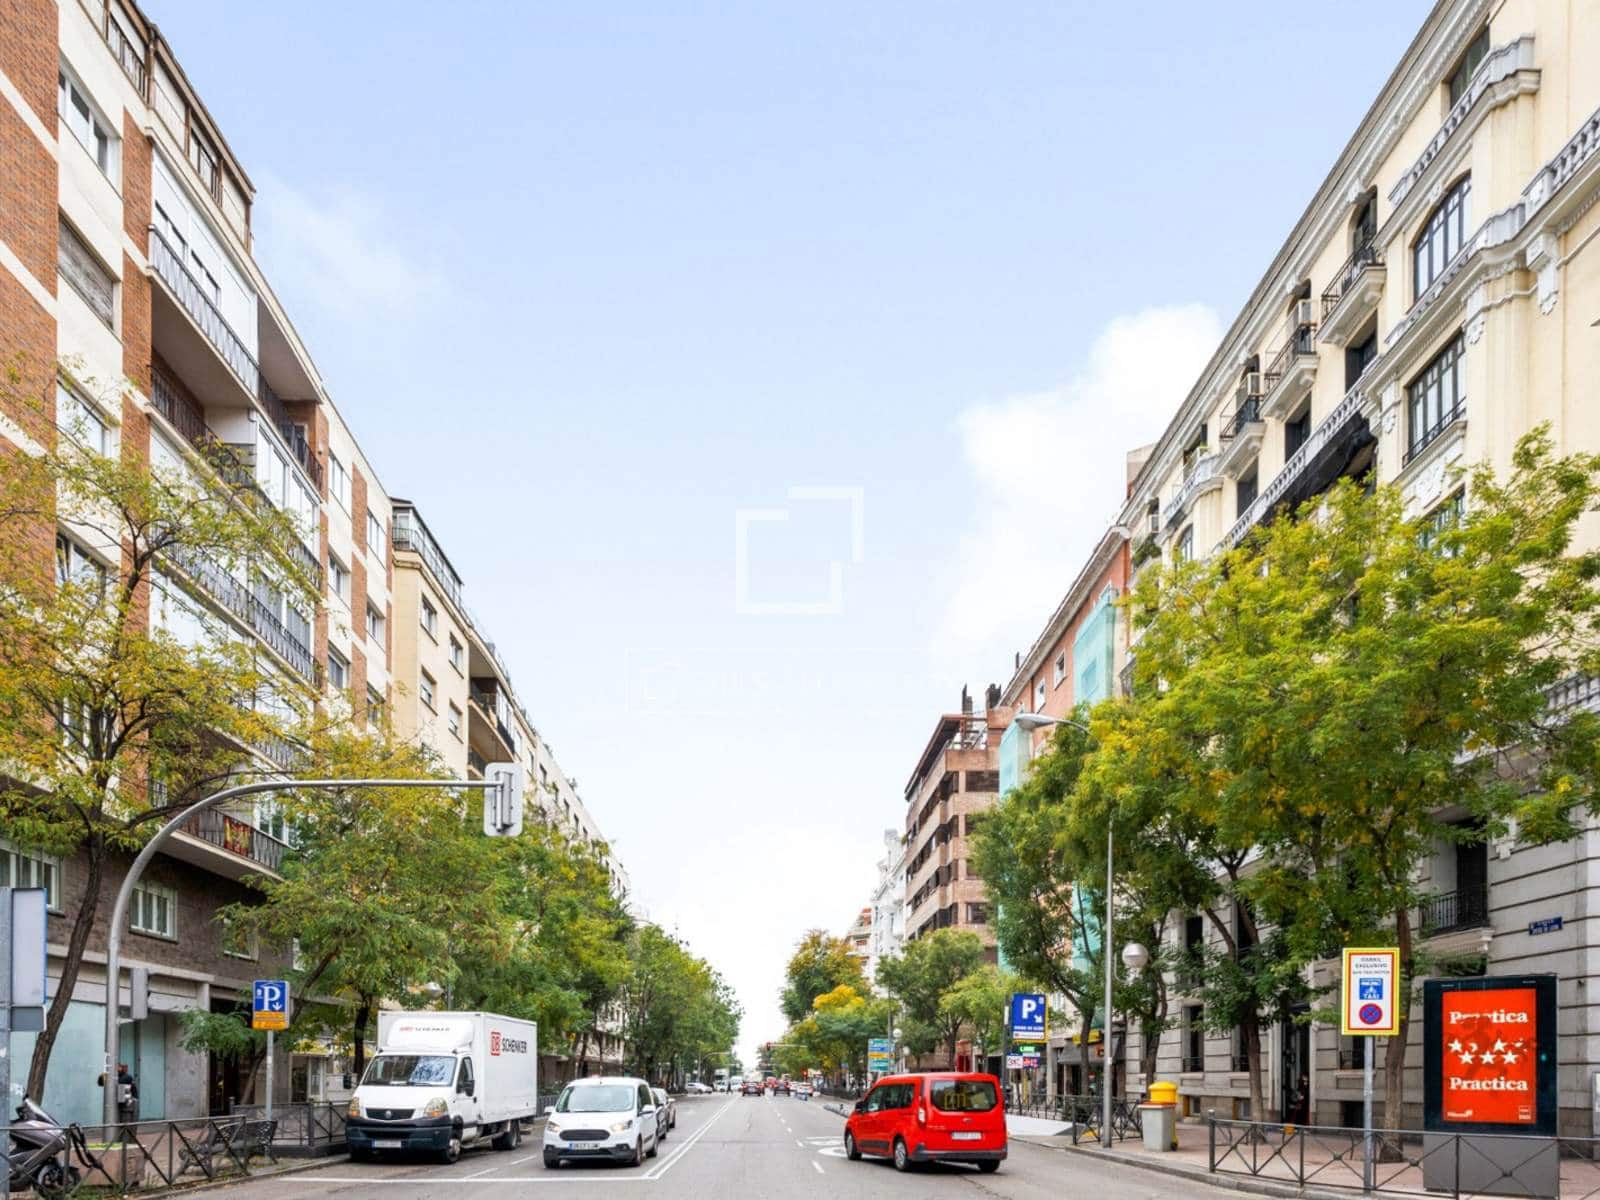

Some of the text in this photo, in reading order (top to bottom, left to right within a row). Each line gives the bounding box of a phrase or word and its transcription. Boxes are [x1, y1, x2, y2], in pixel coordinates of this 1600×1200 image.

[263, 985, 281, 1011] P
[1022, 999, 1037, 1019] P
[490, 1033, 527, 1054] DB SCHENKER
[1449, 1076, 1528, 1091] Practica
